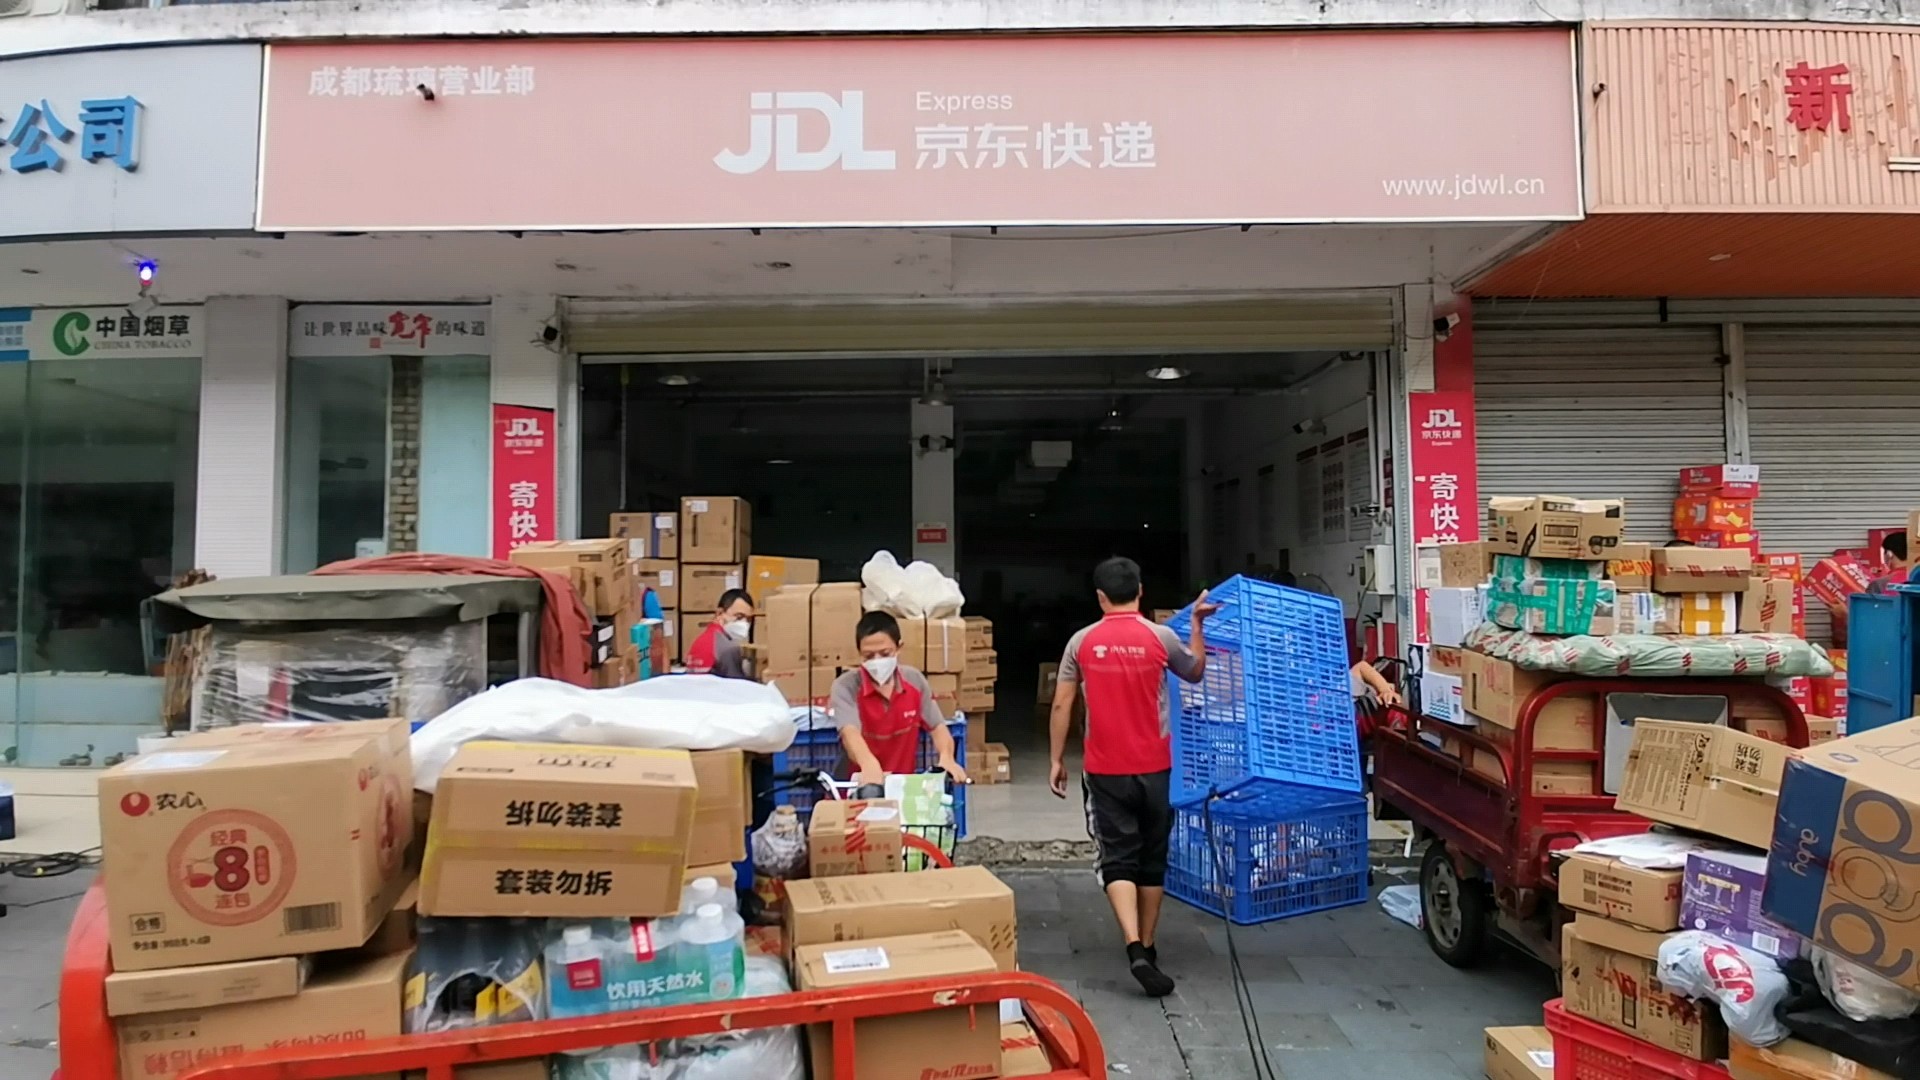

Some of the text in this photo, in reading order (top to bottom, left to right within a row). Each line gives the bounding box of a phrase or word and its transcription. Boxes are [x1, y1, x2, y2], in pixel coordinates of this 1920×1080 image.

[308, 66, 536, 98] 成都琉璃营业部
[916, 91, 1013, 115] Express
[1784, 61, 1853, 132] 新
[712, 90, 896, 174] JDL
[914, 121, 1157, 169] 京东快递
[1382, 173, 1545, 200] www.jdwl.cn
[95, 314, 191, 338] 中国烟草
[95, 339, 191, 350] CHINA TOBACCO
[504, 418, 544, 437] JDL
[1422, 409, 1462, 428] JDL
[509, 481, 538, 548] 寄快
[156, 791, 204, 811] 农心
[506, 800, 623, 828] 套装勿拆
[213, 846, 251, 892] 8
[495, 869, 613, 897] 套装勿拆
[606, 970, 703, 1000] 饮用天然水
